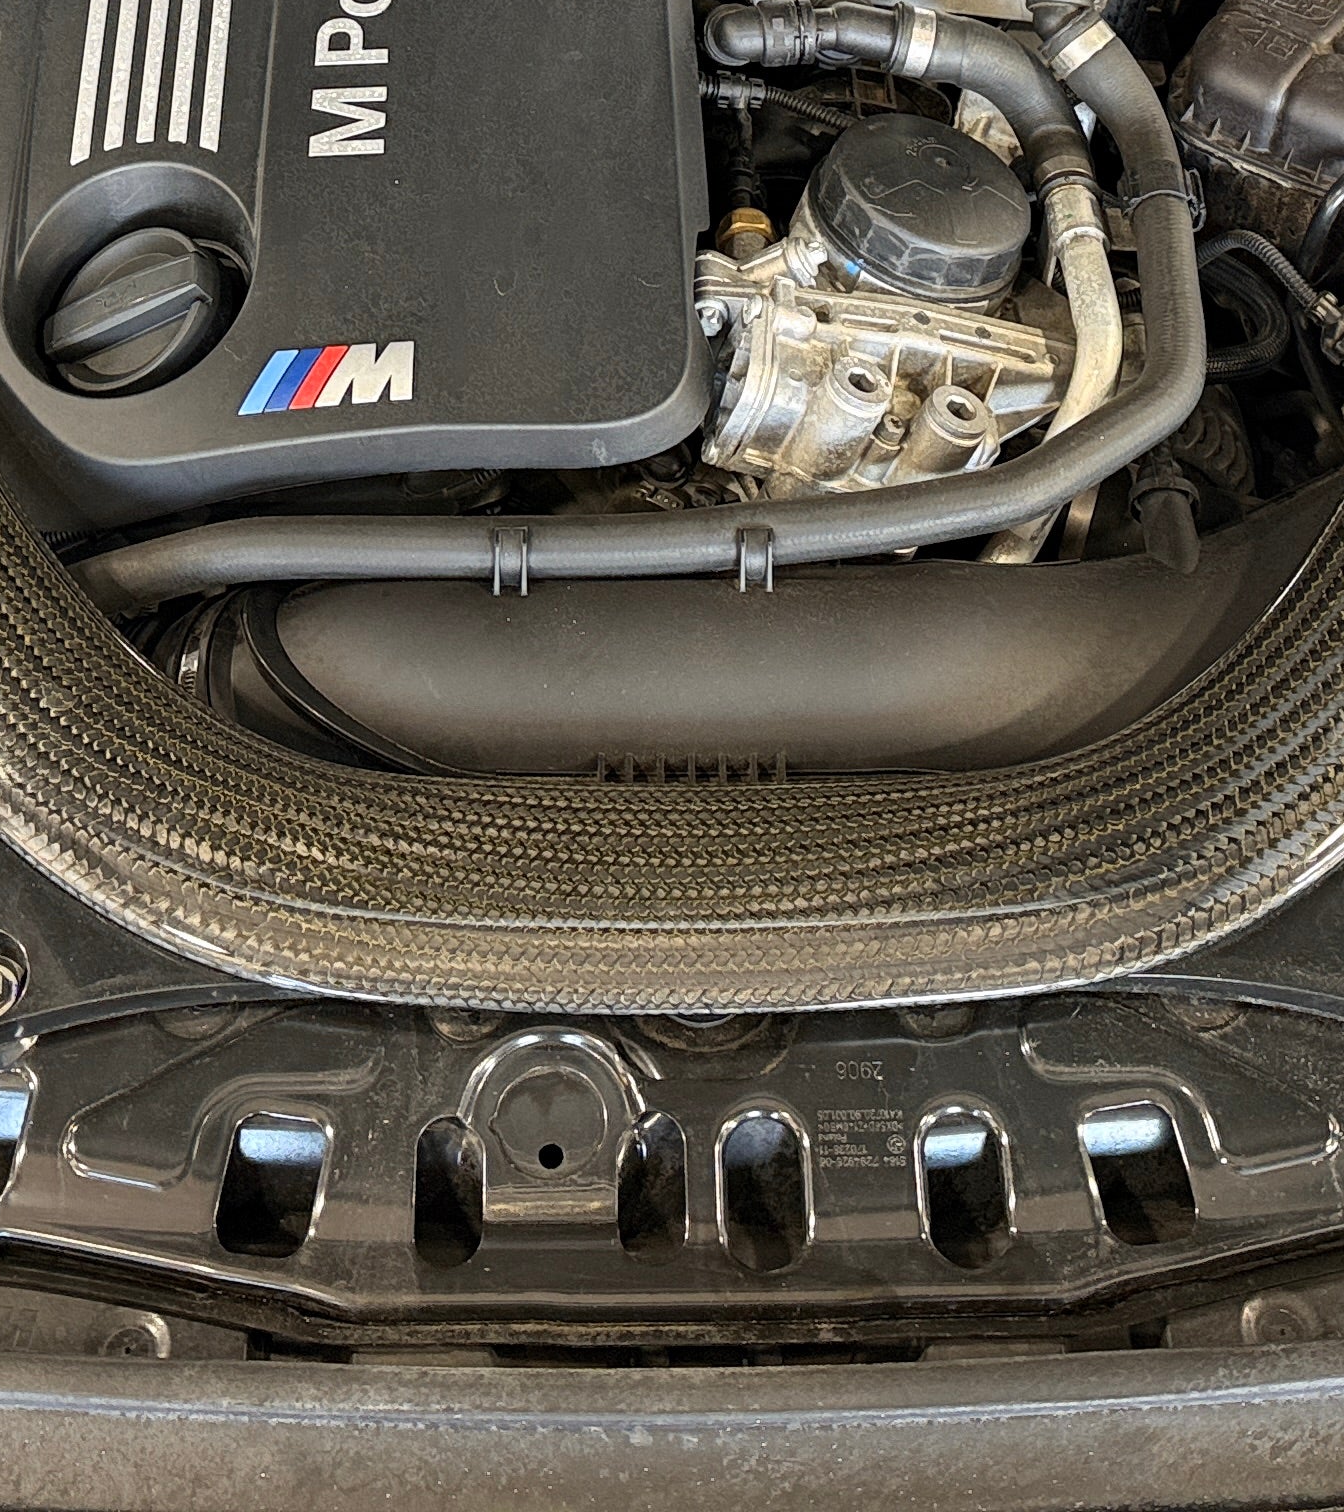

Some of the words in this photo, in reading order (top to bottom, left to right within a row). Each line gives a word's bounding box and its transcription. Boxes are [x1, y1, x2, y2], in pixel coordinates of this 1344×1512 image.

[308, 86, 386, 158] M
[314, 340, 415, 409] M
[835, 1061, 883, 1080] 2906
[818, 1133, 847, 1142] Poland
